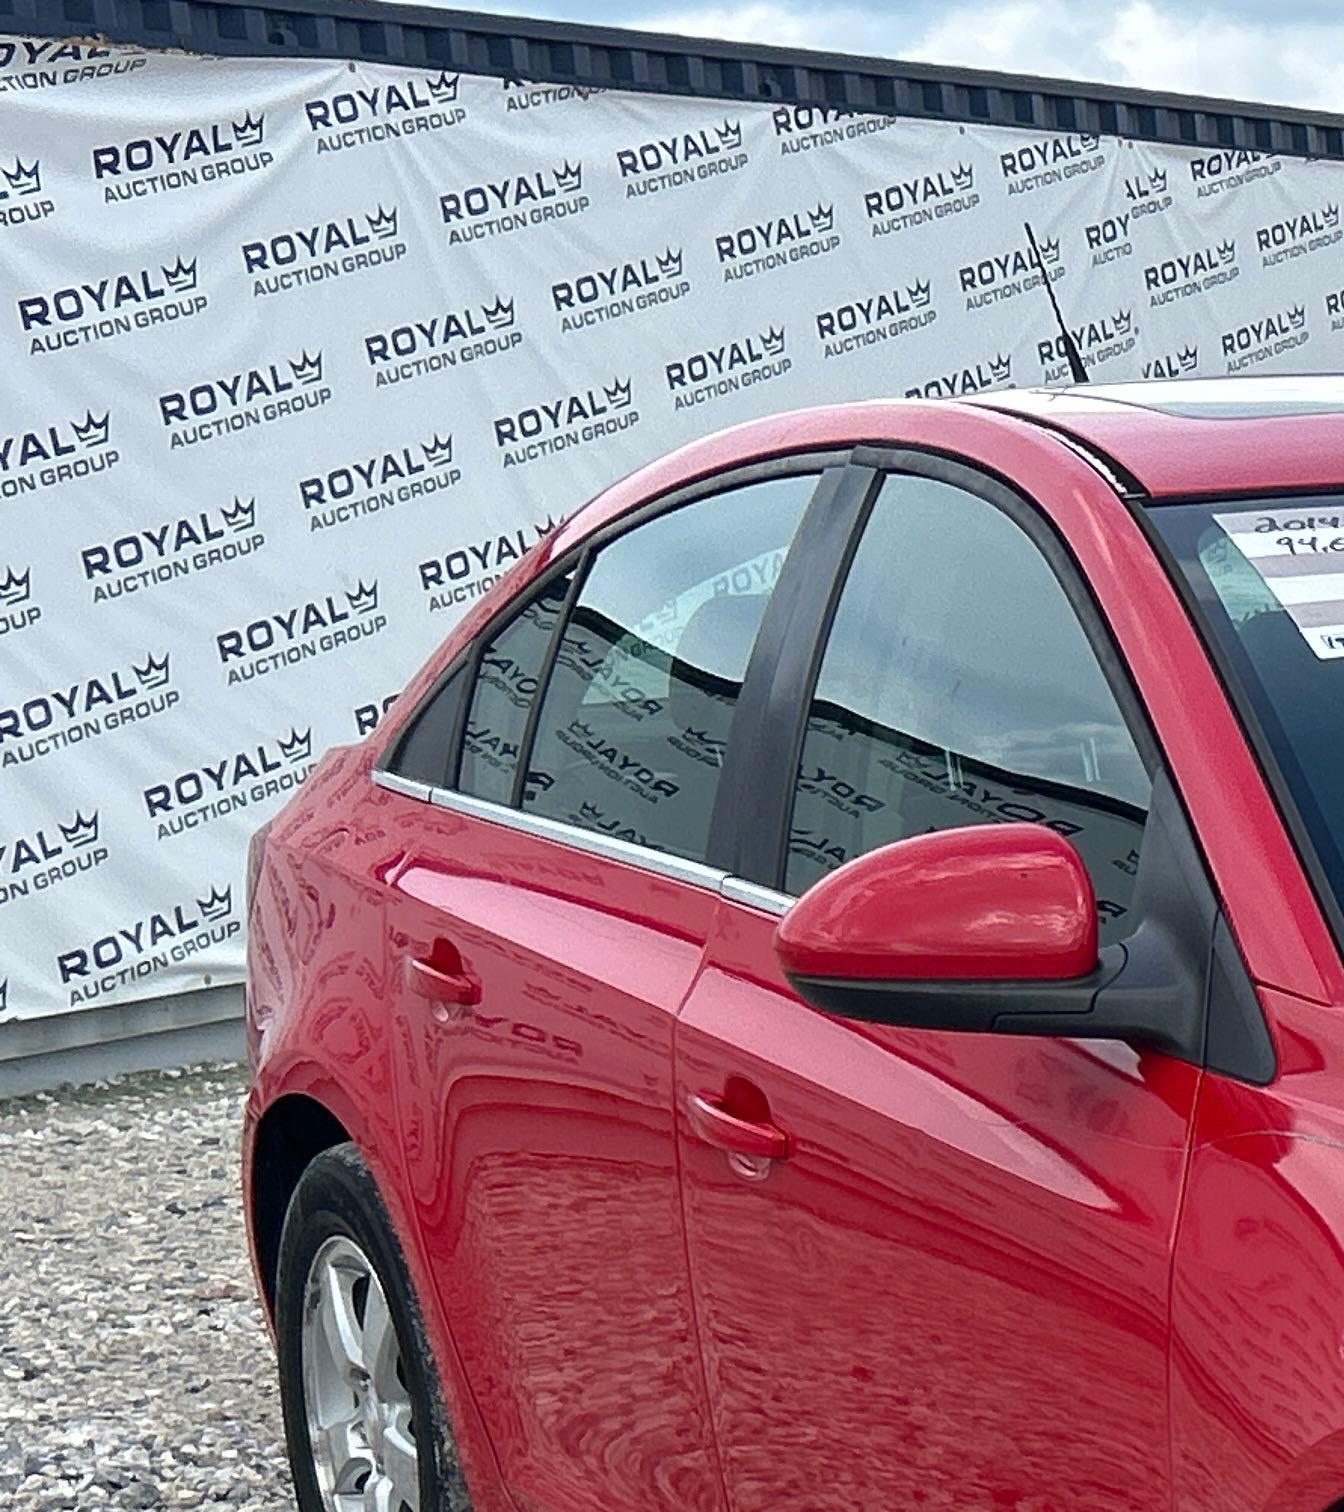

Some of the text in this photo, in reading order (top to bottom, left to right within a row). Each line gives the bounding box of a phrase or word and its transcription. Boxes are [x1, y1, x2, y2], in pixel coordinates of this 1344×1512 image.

[63, 58, 147, 84] GROUP
[304, 78, 432, 134] ROYAL
[317, 108, 466, 154] AUCTION GROUP
[92, 122, 233, 181] ROYAL
[616, 130, 720, 178] ROYAL
[781, 127, 843, 155] AUCTION
[1001, 136, 1081, 177] ROYAL
[104, 152, 274, 204] AUCTION GROUP
[439, 172, 556, 224] ROYAL
[626, 153, 748, 199] AUCTION GROUP
[863, 172, 954, 218] ROYAL
[1008, 155, 1105, 196] AUCTION GROUP
[449, 196, 590, 246] AUCTION GROUP
[716, 214, 812, 263] ROYAL
[872, 194, 980, 238] AUCTION GROUP
[1256, 212, 1324, 252] ROYAL
[241, 218, 370, 274] ROYAL
[254, 242, 406, 298] AUCTION GROUP
[724, 235, 840, 283] AUCTION GROUP
[959, 247, 1041, 291] ROYAL
[1144, 252, 1208, 292] ROYAL
[18, 270, 165, 334] ROYAL
[552, 259, 660, 312] ROYAL
[562, 282, 690, 334] AUCTION GROUP
[966, 280, 1022, 312] AUCTION
[1150, 280, 1202, 308] AUCTION
[30, 296, 208, 356] AUCTION GROUP
[364, 310, 486, 366] ROYAL
[816, 290, 911, 340] ROYAL
[824, 310, 936, 359] AUCTION GROUP
[1222, 314, 1290, 358] ROYAL
[376, 332, 522, 388] AUCTION GROUP
[665, 338, 764, 390] ROYAL
[675, 358, 792, 411] AUCTION GROUP
[158, 365, 294, 427] ROYAL
[170, 388, 332, 450] AUCTION GROUP
[494, 390, 608, 448] ROYAL
[504, 411, 640, 468] AUCTION GROUP
[39, 450, 120, 486] GROUP
[299, 448, 425, 510] ROYAL
[310, 468, 461, 532] AUCTION GROUP
[81, 513, 224, 582] ROYAL
[93, 534, 264, 604] AUCTION GROUP
[419, 531, 531, 590] ROYAL
[216, 596, 350, 664] ROYAL
[228, 616, 386, 686] AUCTION GROUP
[2, 690, 180, 768] AUCTION GROUP
[144, 746, 282, 818] ROYAL
[158, 791, 248, 841] AUCTION
[33, 848, 108, 890] GROUP
[56, 905, 200, 984] ROYAL
[69, 920, 244, 1006] AUCTION GROUP
